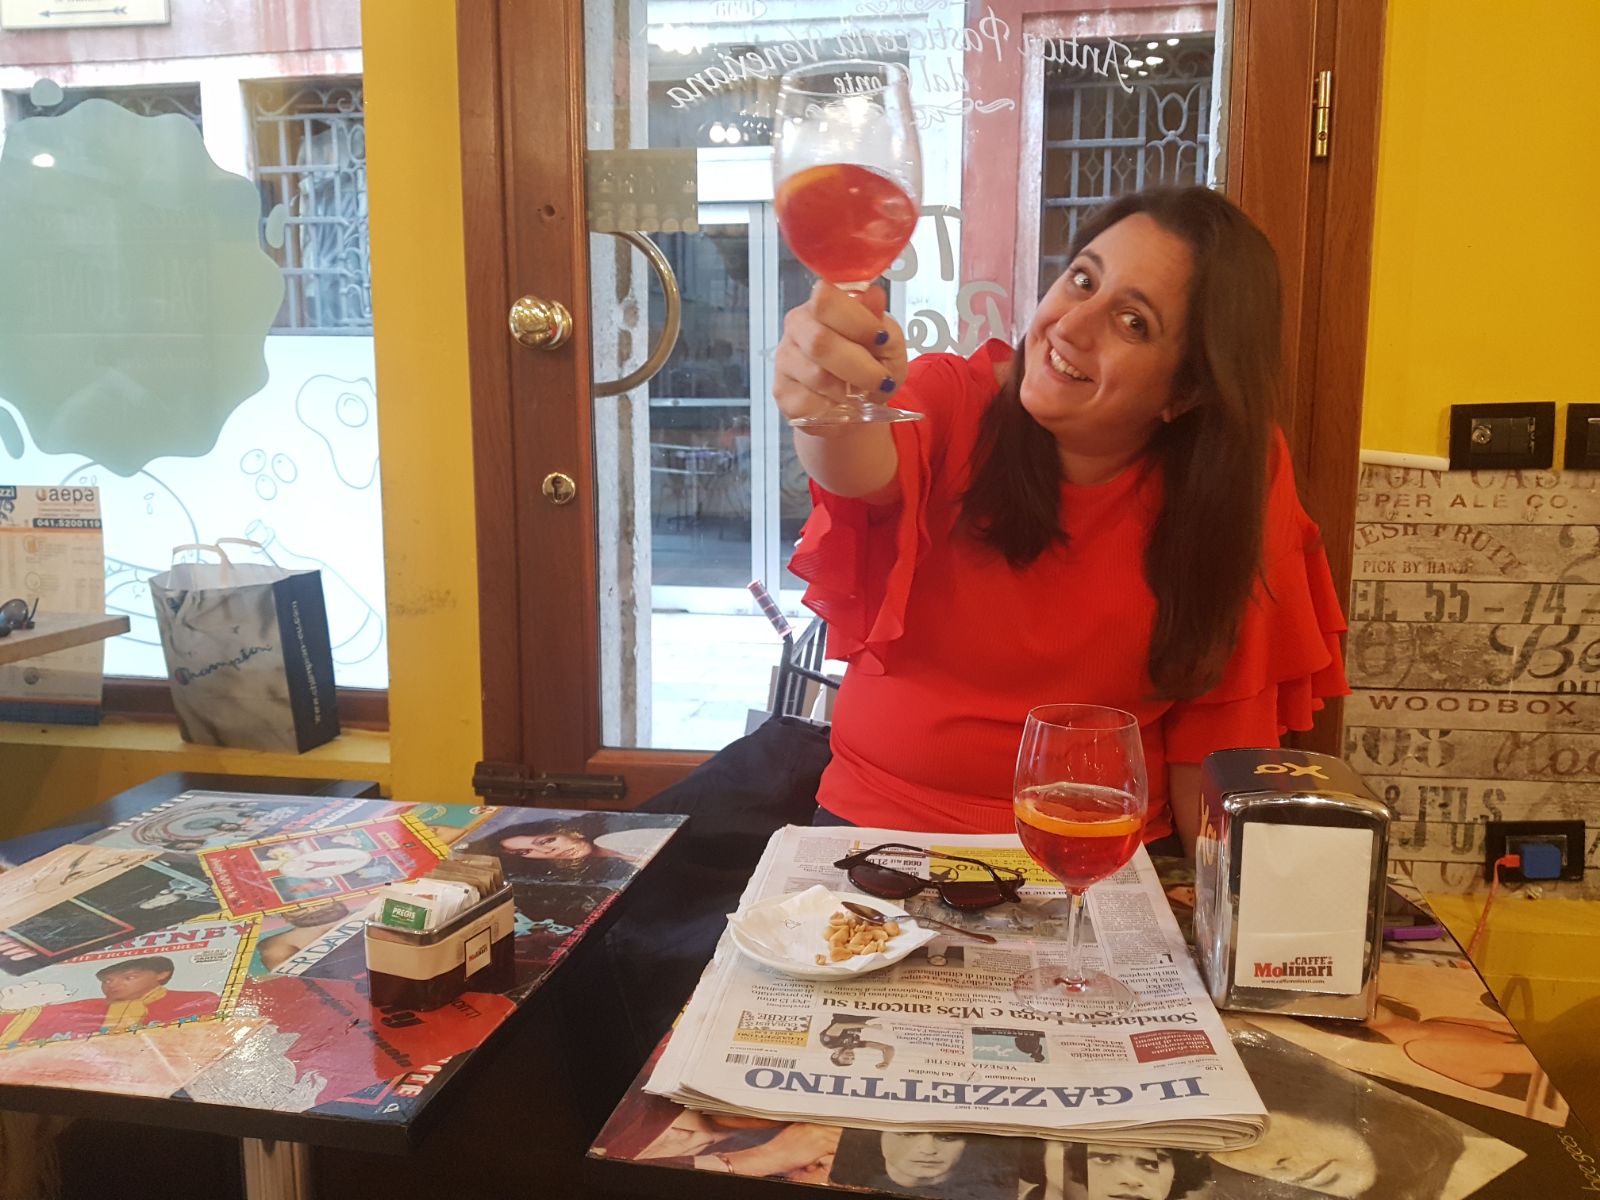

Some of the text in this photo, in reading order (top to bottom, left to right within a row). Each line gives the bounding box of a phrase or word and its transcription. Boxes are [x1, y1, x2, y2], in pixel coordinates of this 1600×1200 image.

[1449, 494, 1509, 509] ALE
[36, 519, 101, 527] 041.5200119
[1355, 523, 1420, 550] ESH
[1362, 560, 1474, 575] PICK BY HAND
[1368, 694, 1577, 716] WOODBOX
[391, 906, 417, 920] PREGIS
[1253, 961, 1334, 977] Molinari
[821, 997, 849, 1010] su
[853, 1001, 932, 1016] ancora
[936, 1005, 984, 1019] M5s
[989, 1007, 1004, 1017] e
[923, 1058, 1017, 1071] VENEZIA MESTRE
[744, 1068, 1210, 1108] IL GAZZETTINO
